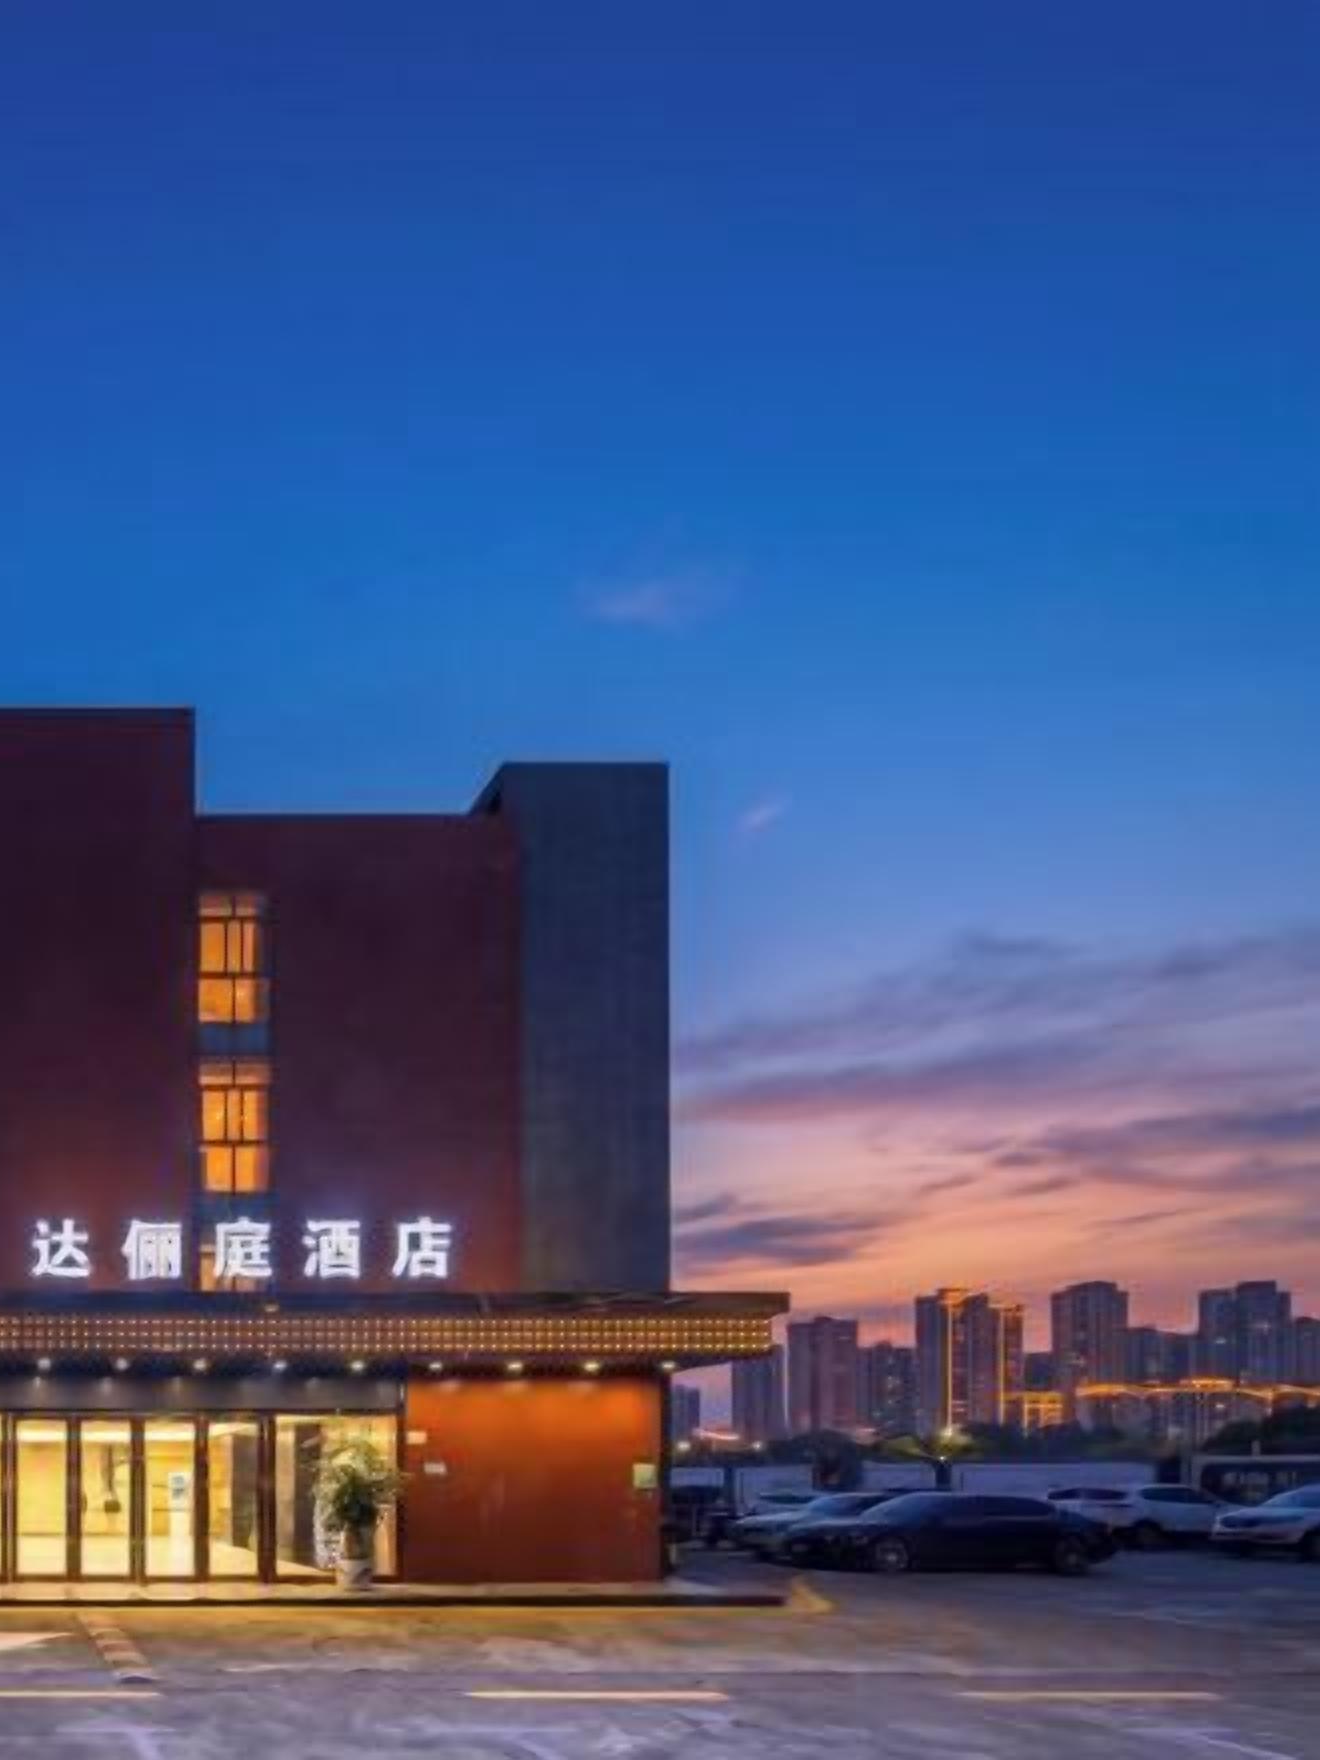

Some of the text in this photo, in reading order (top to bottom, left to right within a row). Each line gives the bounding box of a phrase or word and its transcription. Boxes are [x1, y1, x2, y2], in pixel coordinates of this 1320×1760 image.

[31, 1216, 452, 1280] 达俪庭酒店
